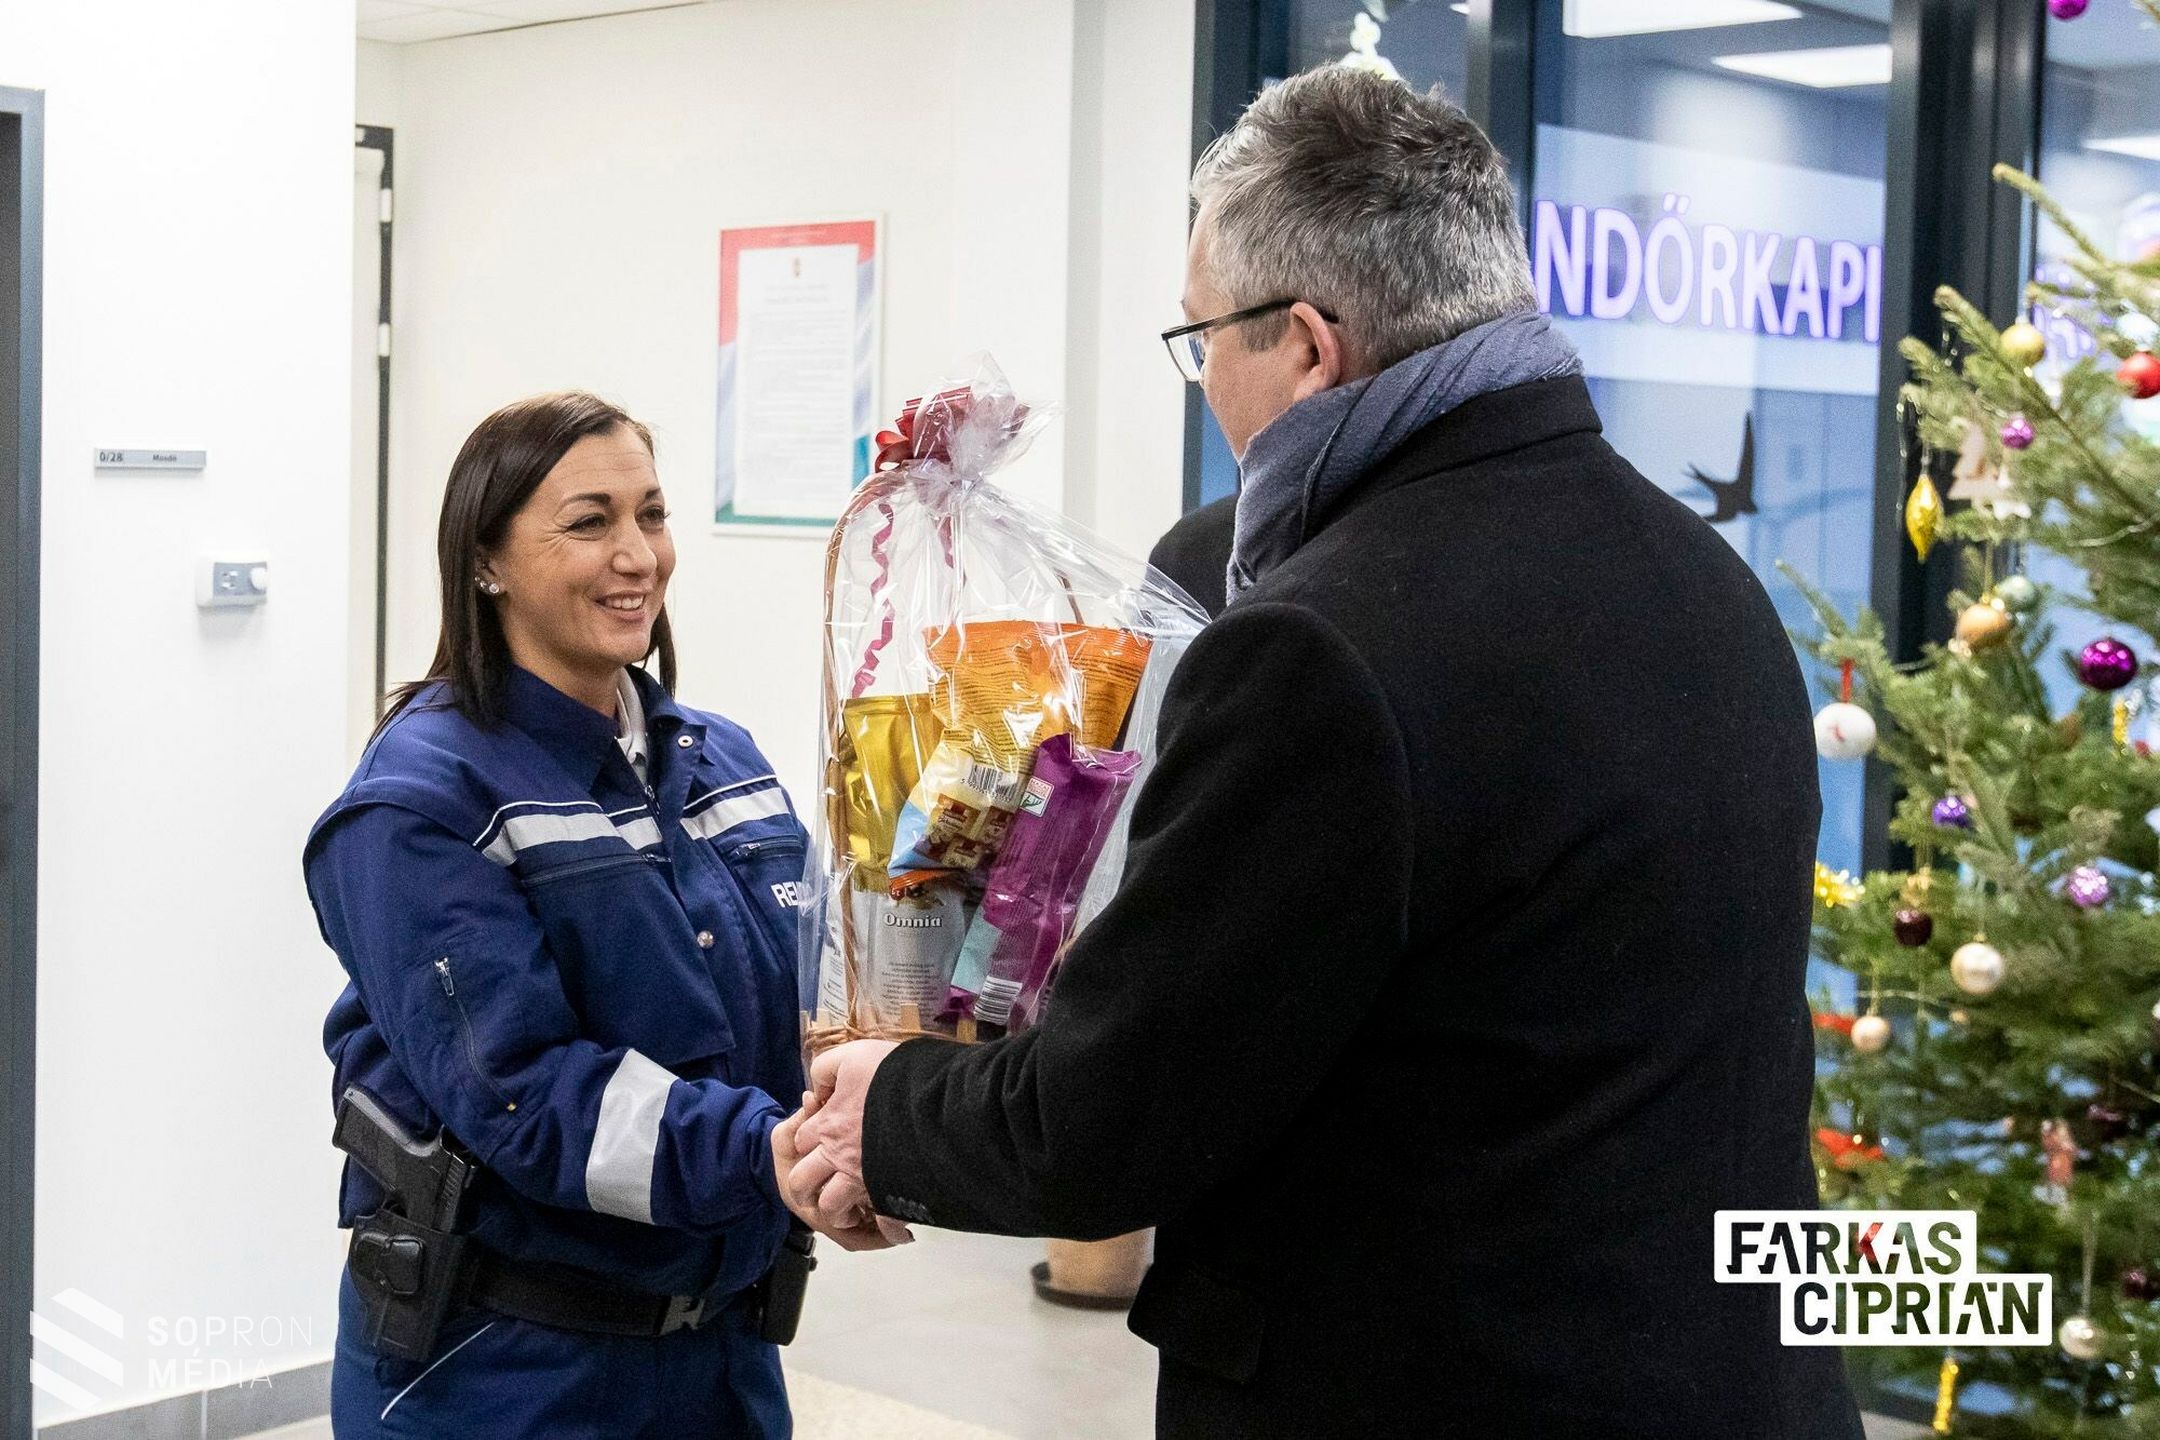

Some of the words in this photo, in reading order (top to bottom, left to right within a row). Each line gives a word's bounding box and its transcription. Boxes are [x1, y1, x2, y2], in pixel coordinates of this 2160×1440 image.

[1534, 193, 1882, 343] NDŐRKAPI
[99, 451, 123, 462] 0/28
[883, 912, 943, 928] Omnia
